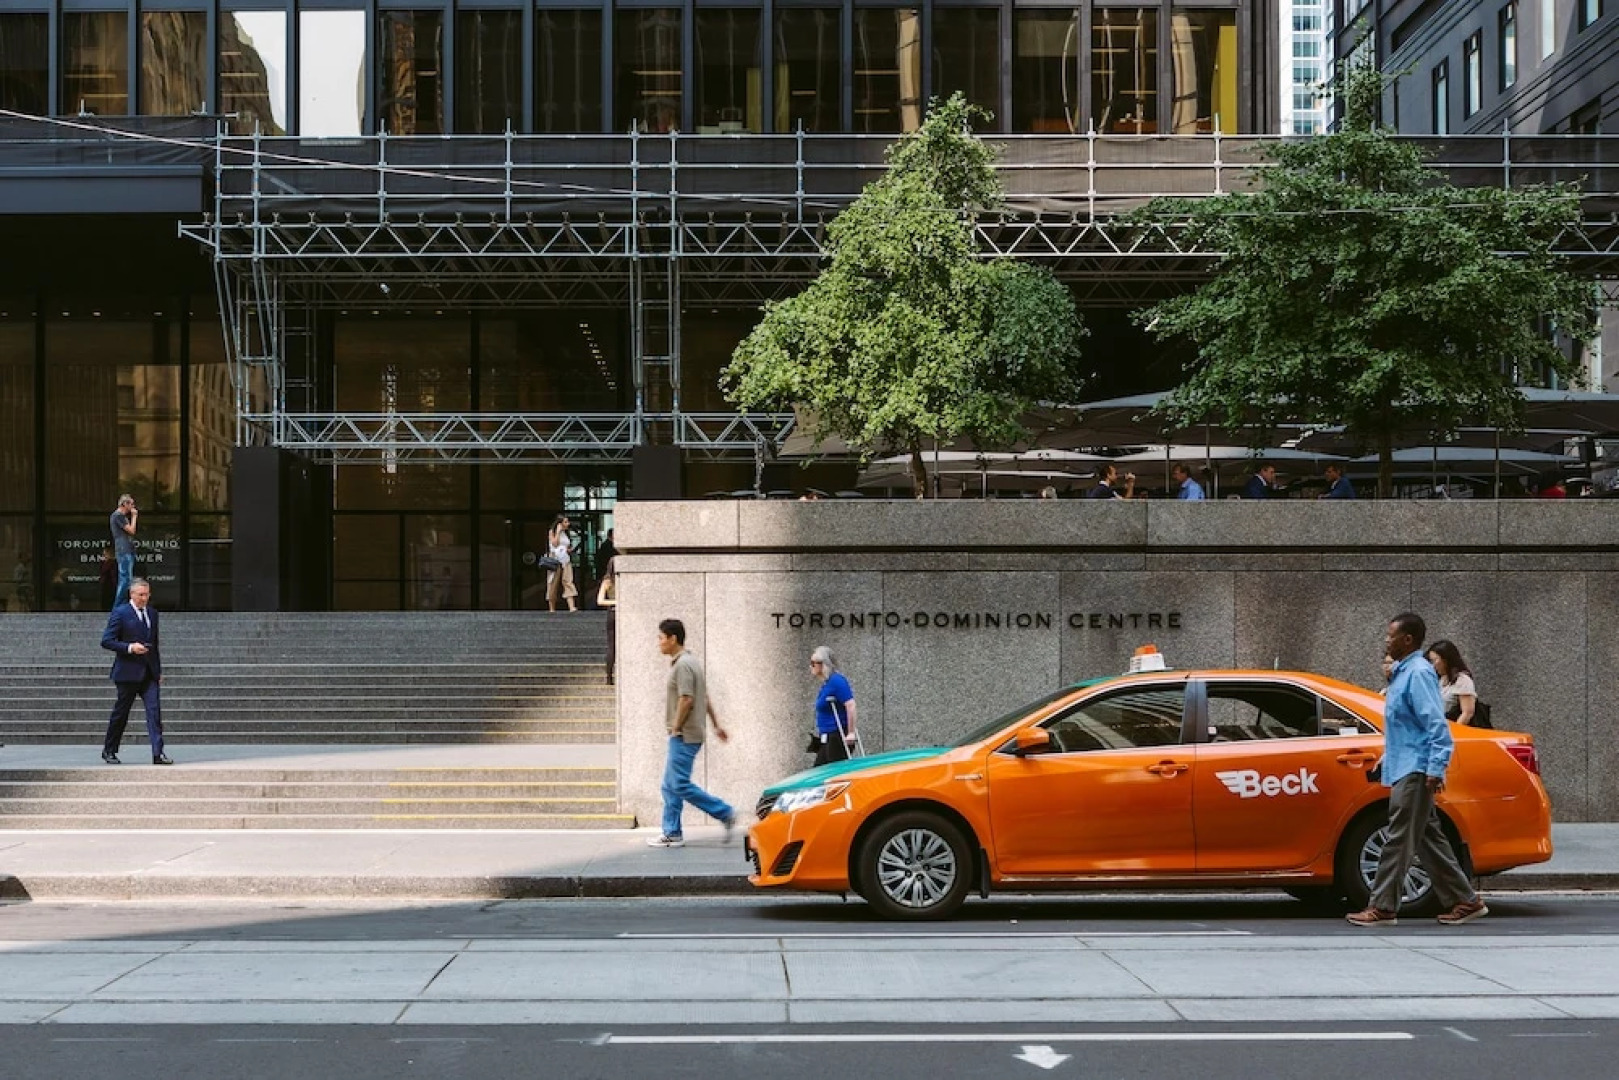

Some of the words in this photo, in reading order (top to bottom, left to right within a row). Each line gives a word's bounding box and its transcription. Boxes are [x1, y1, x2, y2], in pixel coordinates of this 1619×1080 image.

[81, 554, 105, 562] BAN
[136, 554, 163, 562] WER
[1069, 613, 1181, 629] CENTRE
[1236, 767, 1320, 798] Beck
